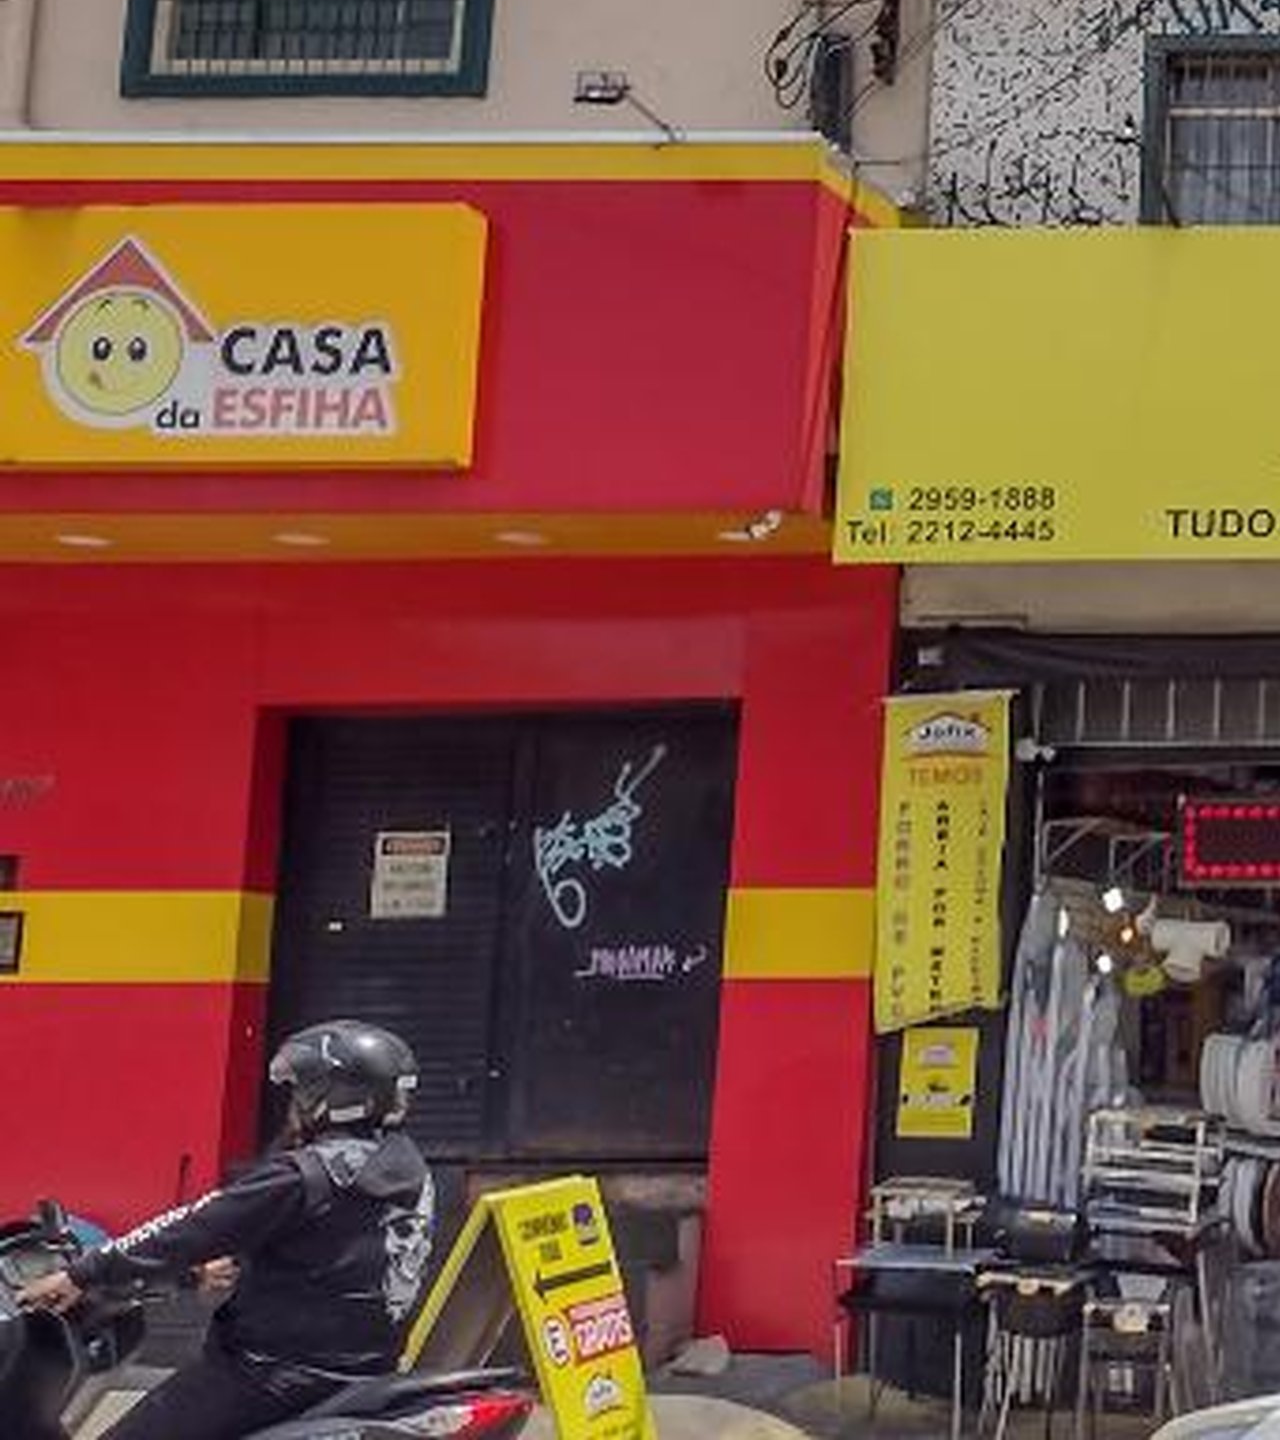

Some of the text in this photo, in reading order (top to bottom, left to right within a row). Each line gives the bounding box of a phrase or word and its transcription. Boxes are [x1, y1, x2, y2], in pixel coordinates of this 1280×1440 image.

[220, 327, 392, 375] CASA
[156, 388, 388, 429] da ESFIHA
[908, 486, 1056, 510] 2959-1888
[907, 520, 1055, 544] 2212-4445
[1165, 509, 1275, 538] TUDO
